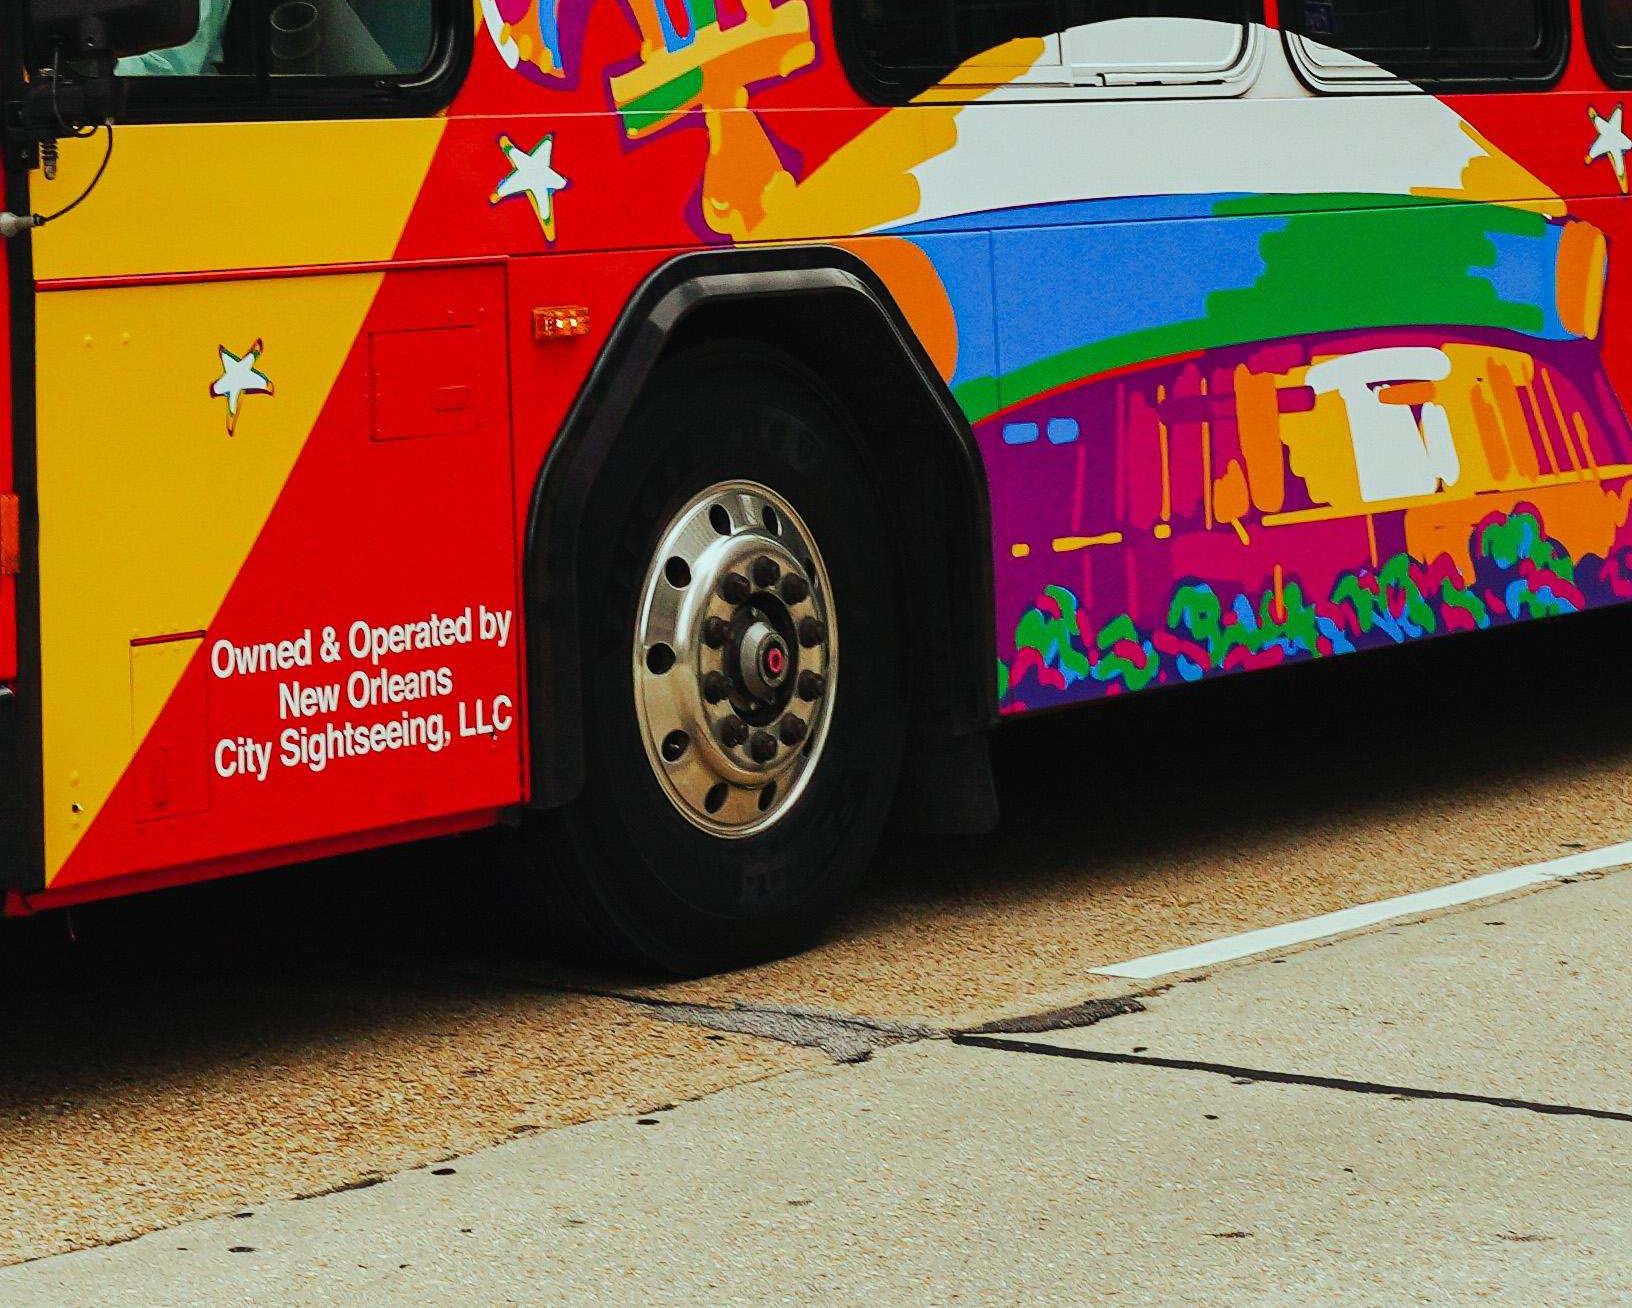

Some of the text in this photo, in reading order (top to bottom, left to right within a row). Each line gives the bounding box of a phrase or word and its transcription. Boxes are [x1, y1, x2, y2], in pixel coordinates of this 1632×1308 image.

[211, 605, 512, 679] Owned & Operated by
[278, 666, 453, 720] New Orleans
[214, 694, 513, 781] City Sightseeing, LLC
